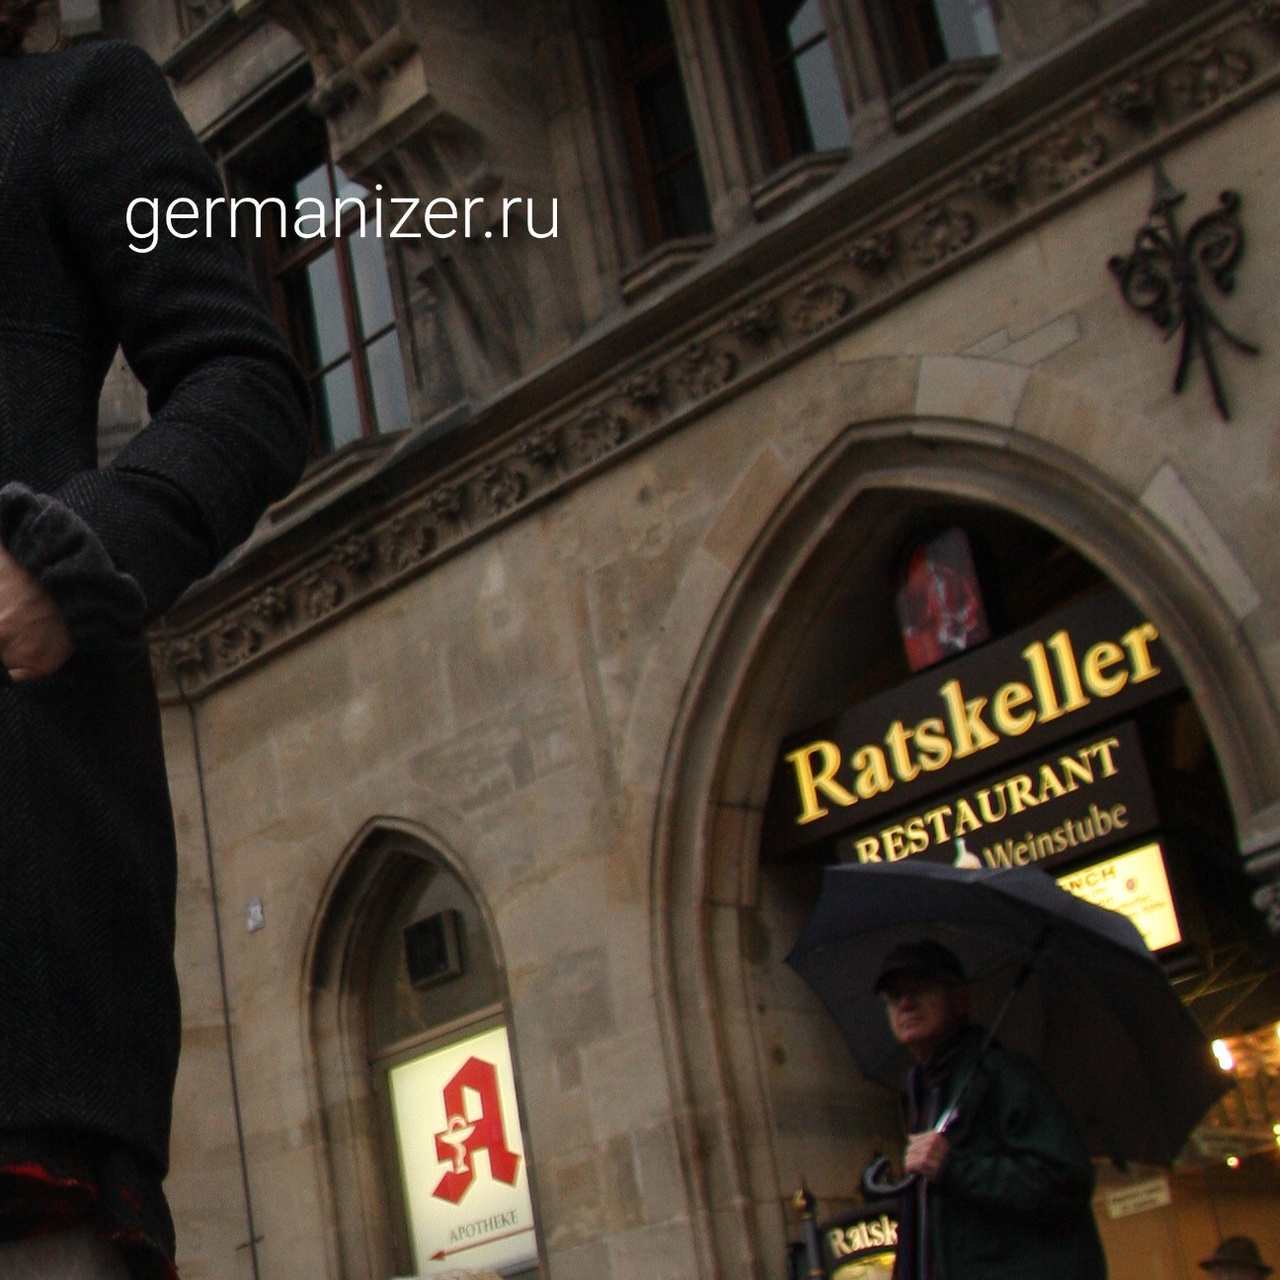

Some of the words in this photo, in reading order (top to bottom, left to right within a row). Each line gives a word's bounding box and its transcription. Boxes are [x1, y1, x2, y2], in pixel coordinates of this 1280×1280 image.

[784, 622, 1162, 826] Ratskeller
[854, 736, 1120, 866] RESTAURANT
[981, 800, 1130, 871] Weinstube
[1066, 866, 1117, 891] NCH
[448, 1209, 518, 1244] APOTHEKE
